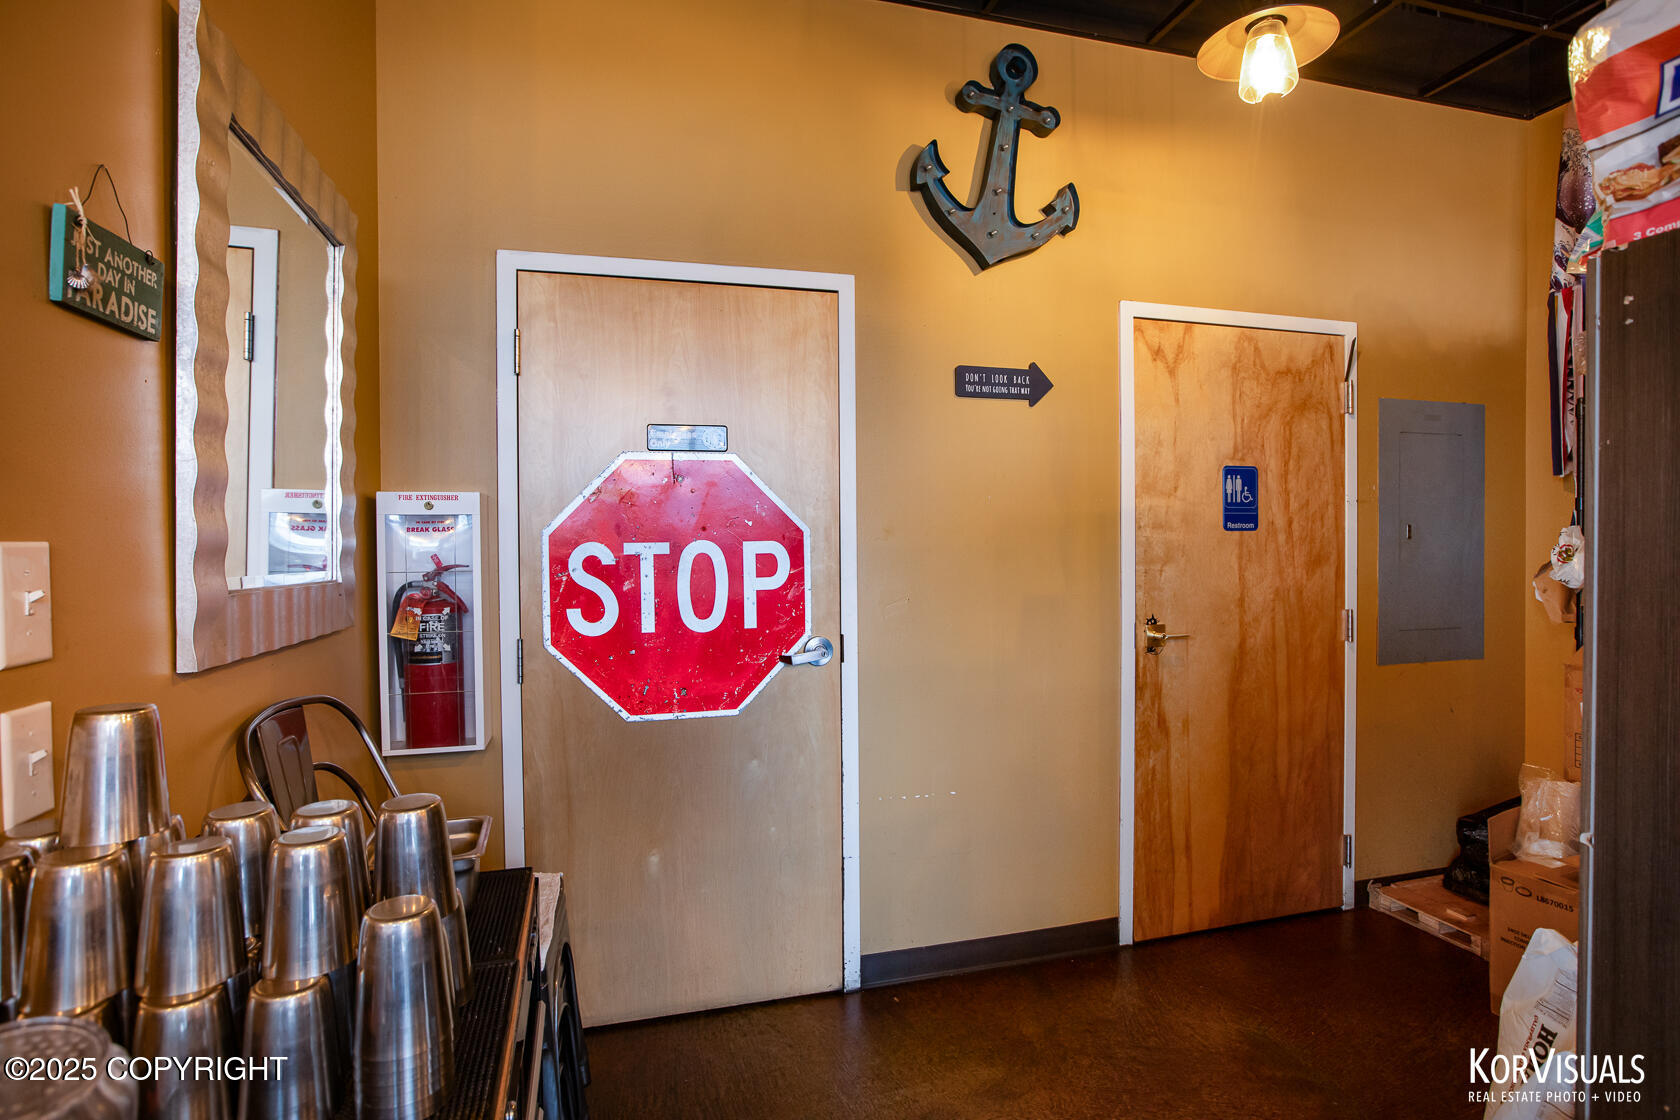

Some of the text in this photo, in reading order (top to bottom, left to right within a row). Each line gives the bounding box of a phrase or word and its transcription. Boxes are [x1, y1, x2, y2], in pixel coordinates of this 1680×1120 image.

[1632, 231, 1642, 240] 3
[104, 247, 158, 289] ANOTHER
[97, 262, 136, 297] DAY IN
[965, 373, 1030, 385] DON'T LOOK BACK
[965, 384, 1030, 395] YOU'RE NOT GOING THAT WAY
[1226, 521, 1255, 529] Restroom
[566, 540, 791, 637] STOP
[419, 622, 445, 632] FIRE
